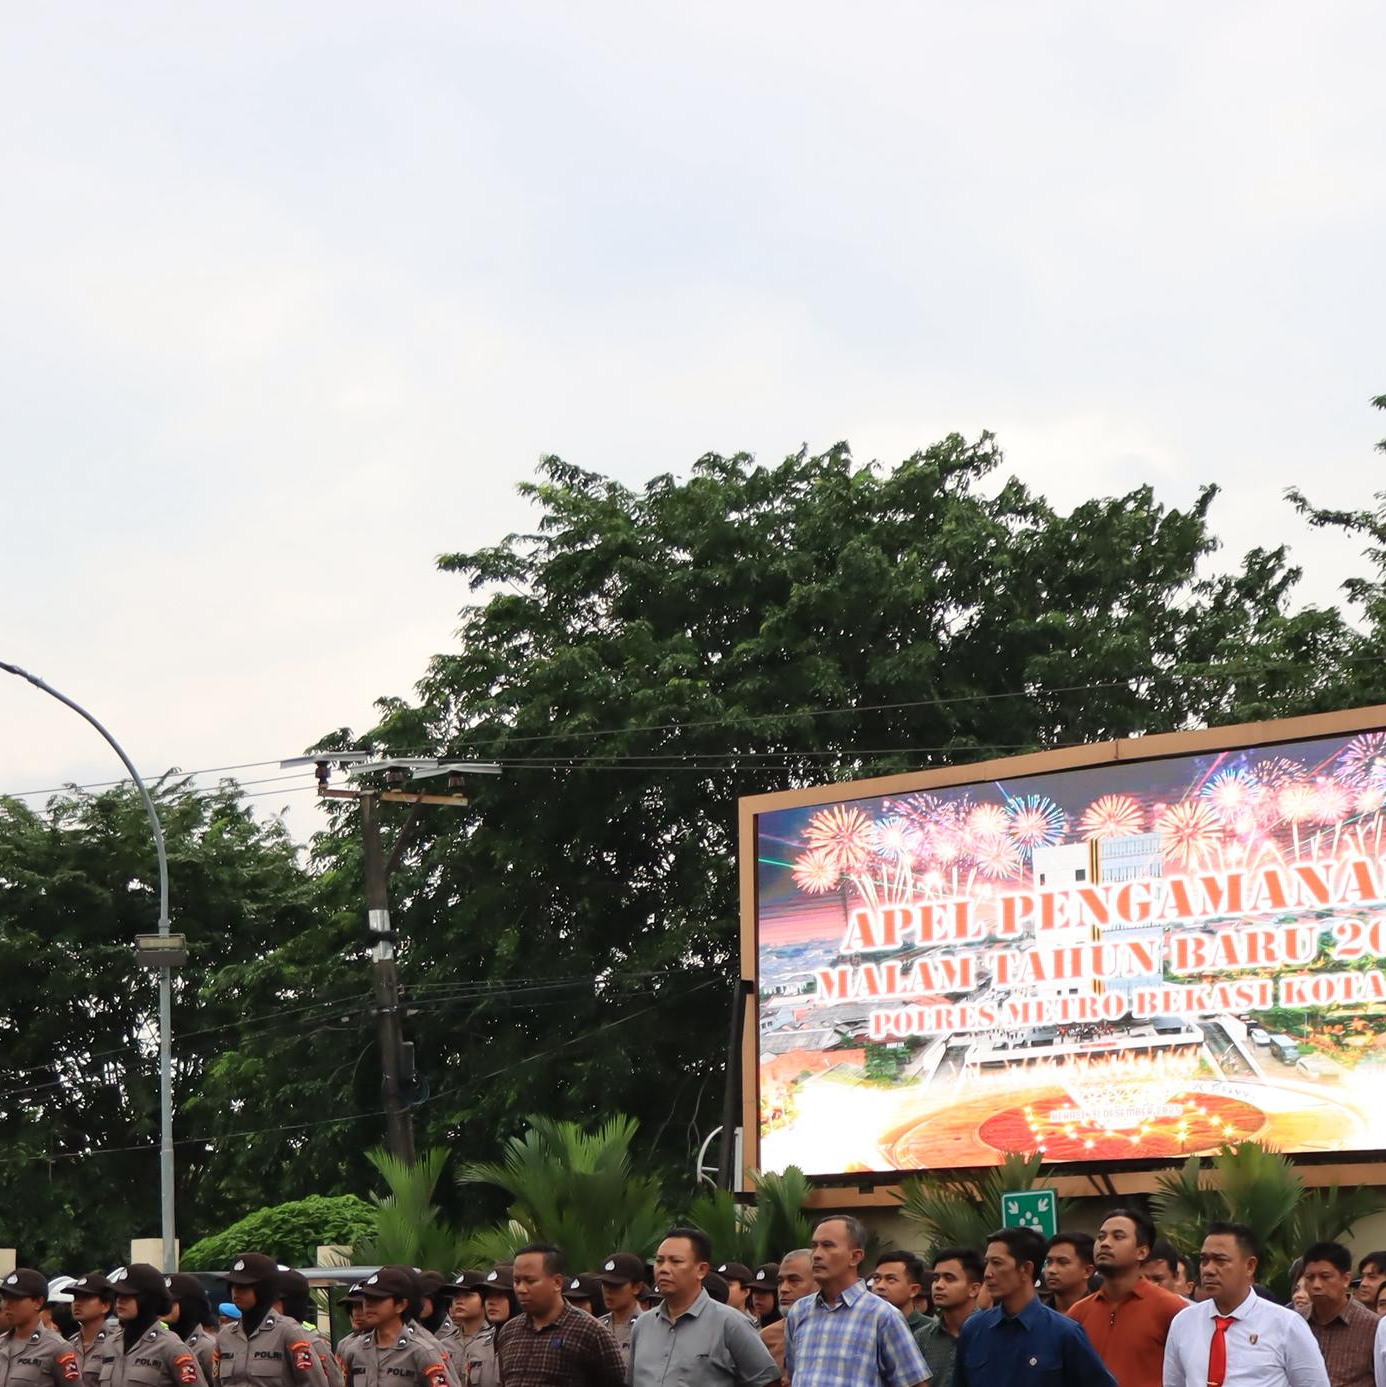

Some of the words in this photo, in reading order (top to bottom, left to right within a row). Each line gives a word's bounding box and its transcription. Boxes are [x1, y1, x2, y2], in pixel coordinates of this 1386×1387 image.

[844, 901, 983, 949] APEL
[818, 956, 974, 1000] MALAM
[989, 940, 1159, 985] TAHUN
[1175, 927, 1316, 970] BARU
[873, 1006, 994, 1035] POLRES
[1009, 993, 1124, 1024] METRO
[1137, 983, 1269, 1014] BEKASI
[1282, 974, 1385, 1004] KOTA
[134, 1358, 162, 1368] POLRI
[254, 1351, 283, 1359] POLRI
[387, 1367, 416, 1377] POLRI
